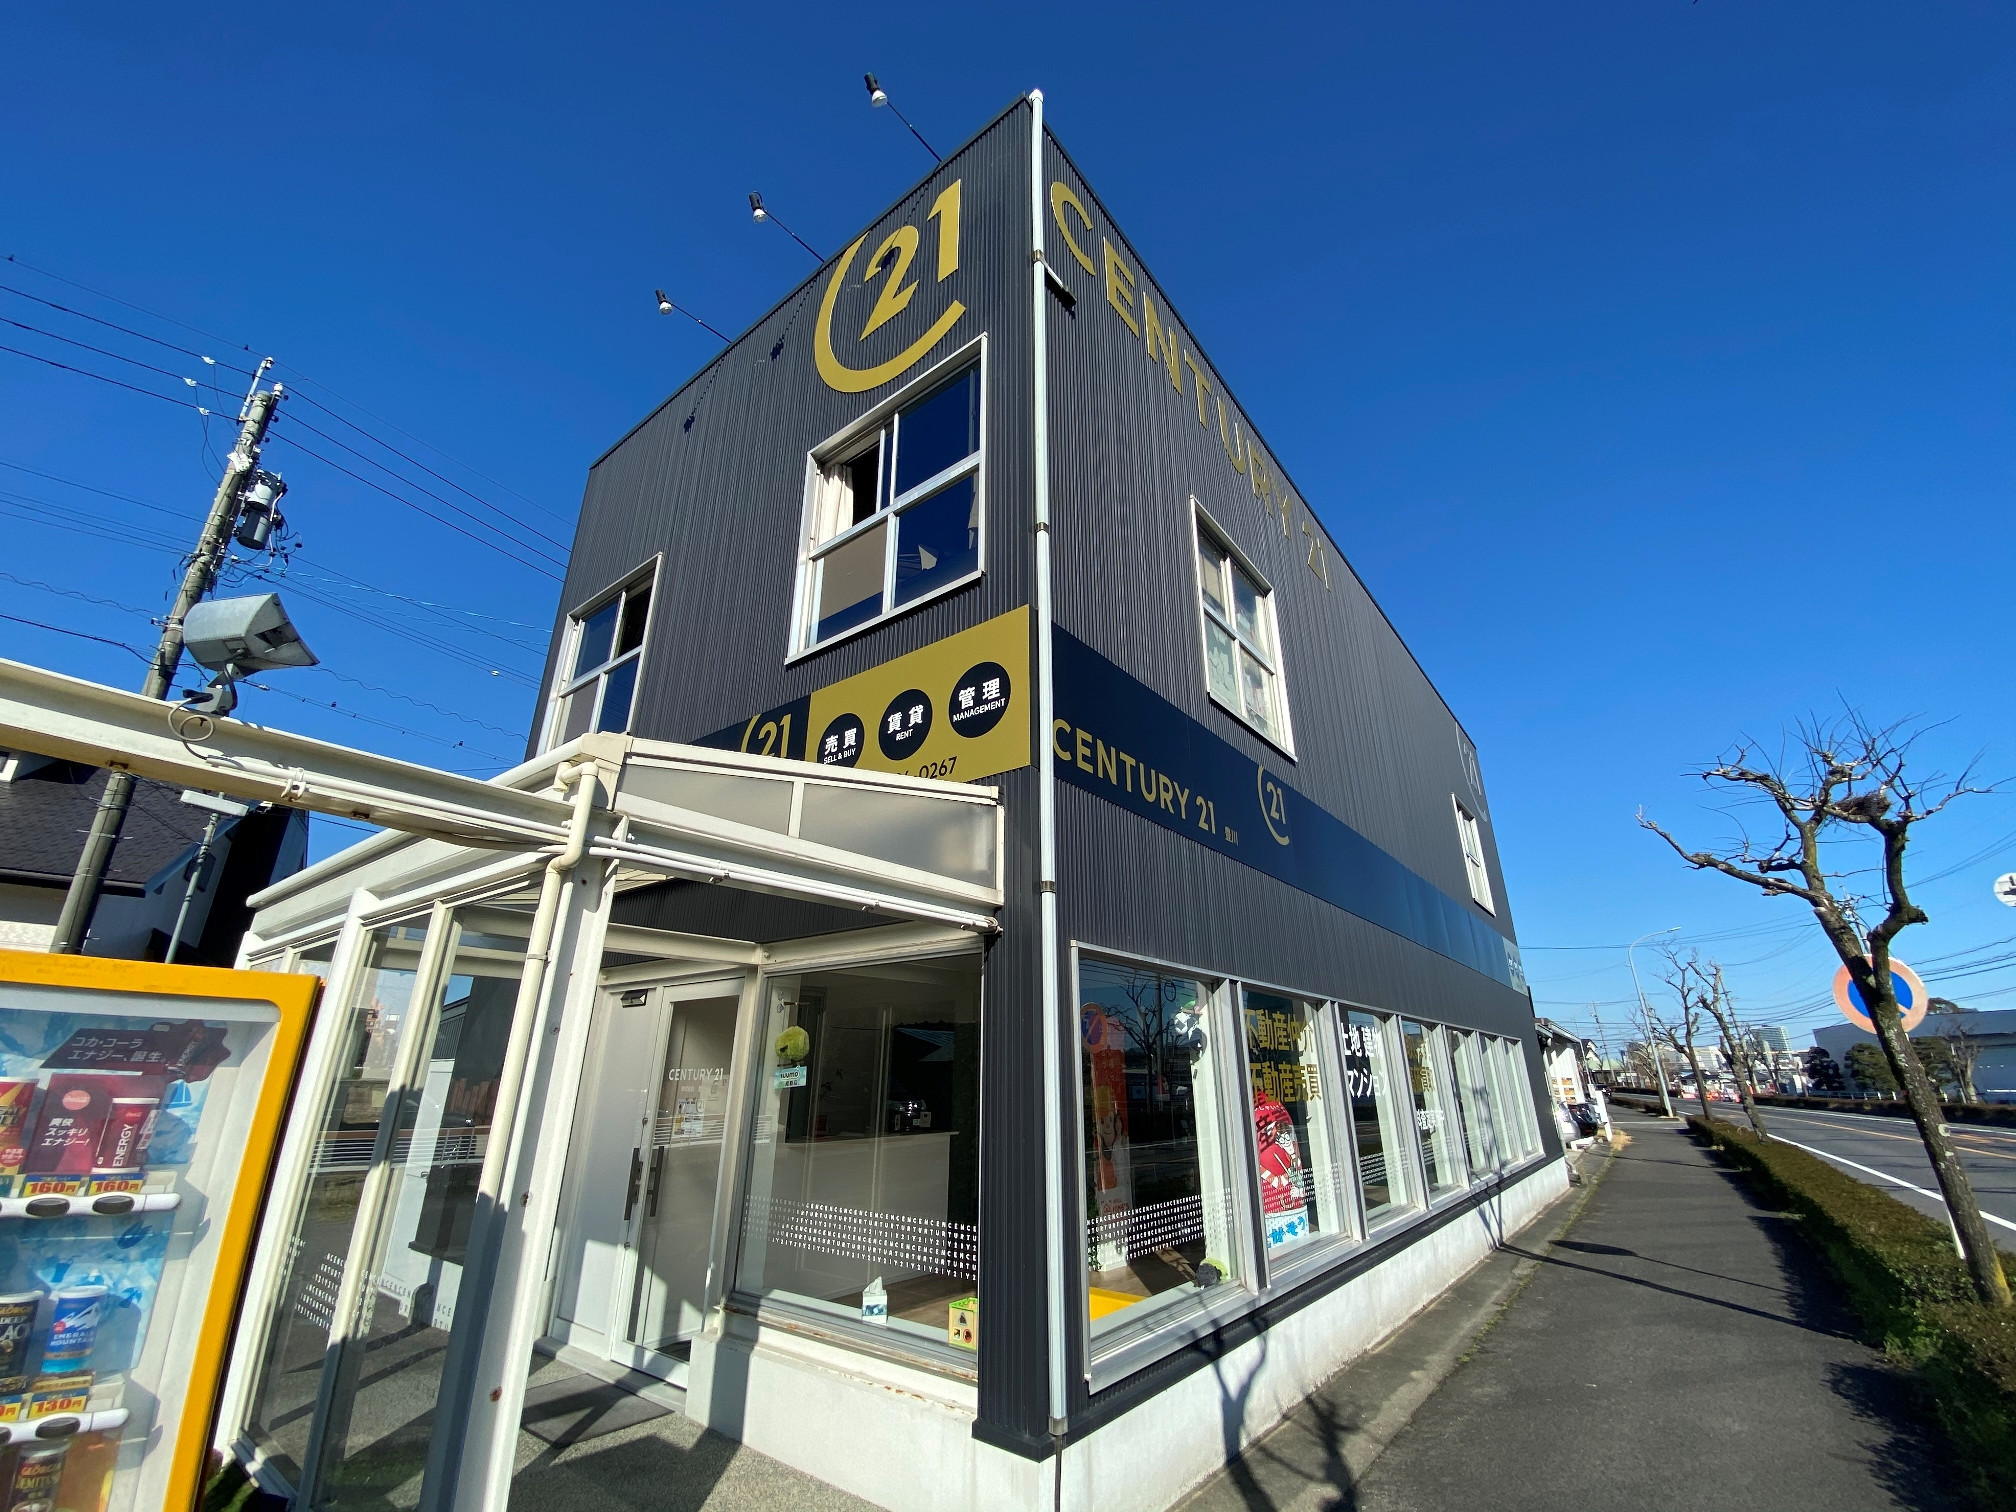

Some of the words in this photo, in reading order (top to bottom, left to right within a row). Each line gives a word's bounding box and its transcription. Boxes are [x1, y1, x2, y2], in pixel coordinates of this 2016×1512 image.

[1050, 181, 1290, 539] CENTURY
[1302, 520, 1331, 593] 21
[958, 677, 1002, 710] 管理
[887, 704, 924, 734] 賃貸
[952, 698, 1006, 723] MANAGEMENT
[824, 727, 858, 756] 売買
[895, 728, 914, 742] RENT
[823, 753, 838, 765] SELL
[843, 747, 857, 759] BUY
[1053, 718, 1190, 820] CENTURY
[1196, 796, 1216, 835] 21
[71, 1036, 145, 1048] コカ・コーラ
[1244, 1008, 1314, 1053] 不動産仲介
[668, 1068, 714, 1081] CENTURY
[714, 1067, 724, 1081] 21
[1250, 1061, 1323, 1102] 不動産売買
[45, 1127, 89, 1136] スッキリ
[112, 1123, 135, 1167] ENERGY
[29, 1182, 77, 1194] 160円
[94, 1180, 140, 1193] 160円
[37, 1398, 82, 1413] 130円
